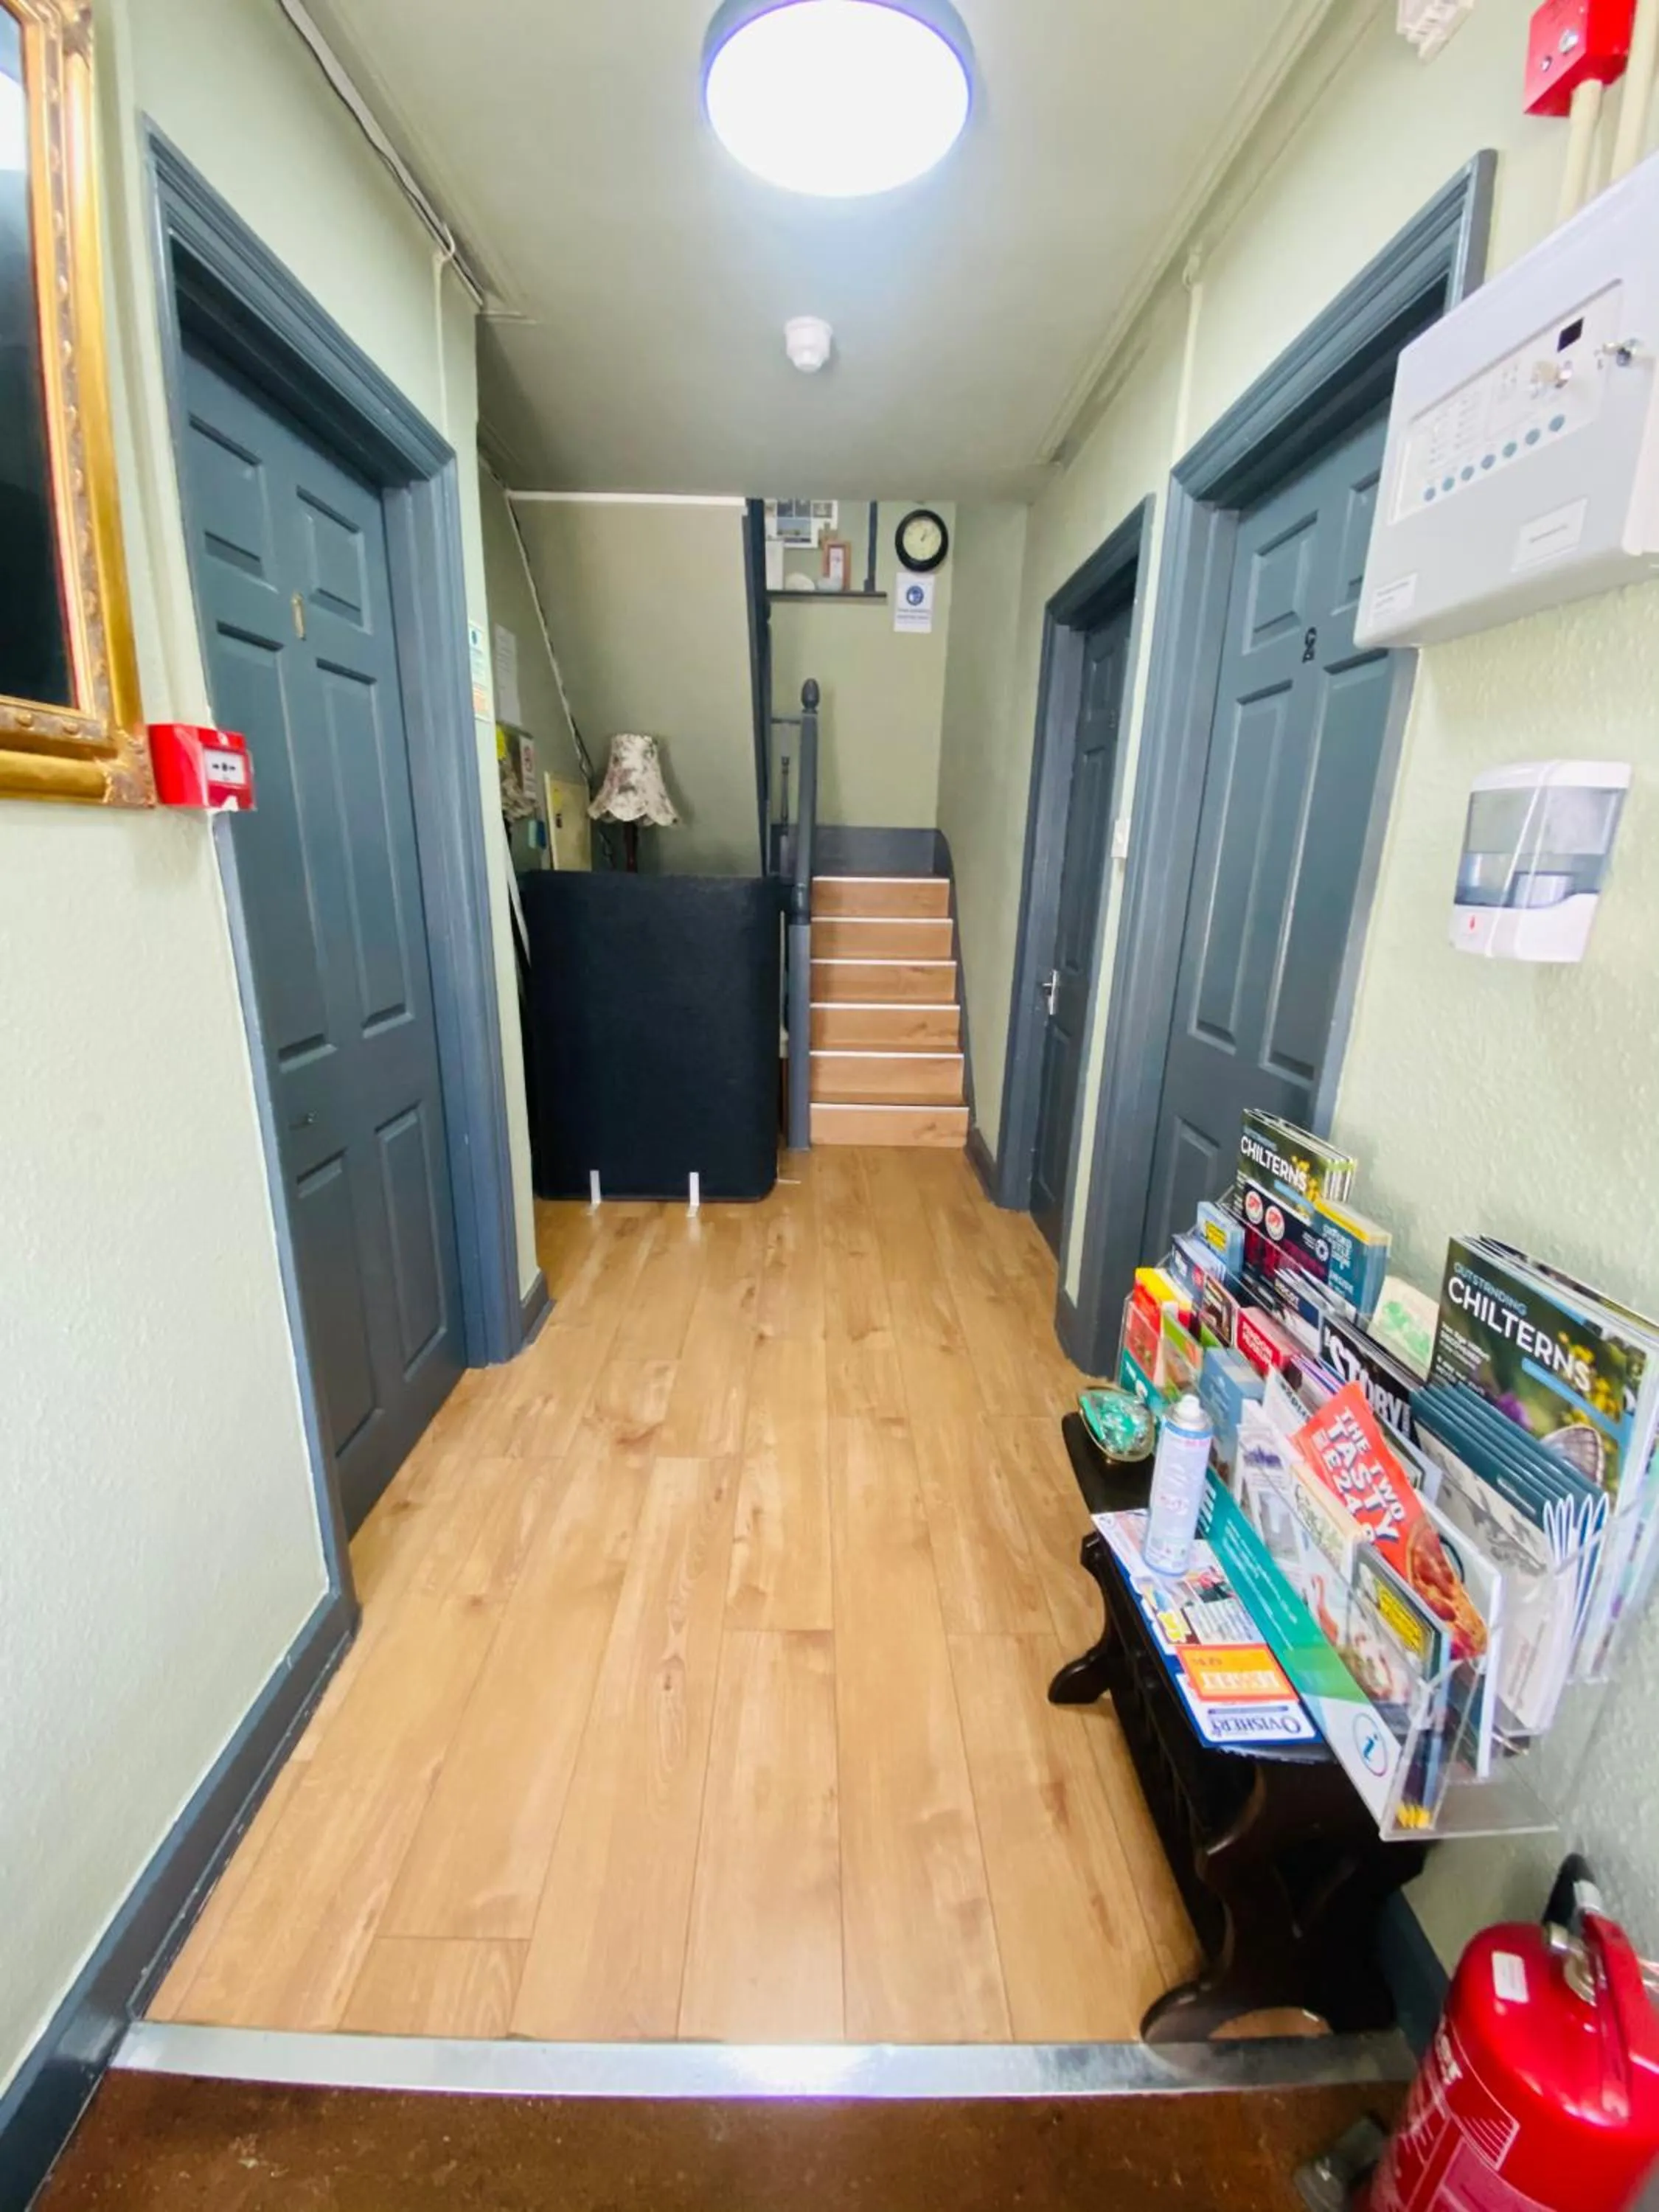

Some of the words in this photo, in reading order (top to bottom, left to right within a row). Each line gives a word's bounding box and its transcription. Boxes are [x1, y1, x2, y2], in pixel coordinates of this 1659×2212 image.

[1240, 1135, 1307, 1192] CHILTERNS
[1449, 1276, 1591, 1392] CHILTERNS
[1324, 1414, 1399, 1538] TASTY
[1338, 1406, 1372, 1455] THE
[1369, 1459, 1405, 1520] TWO
